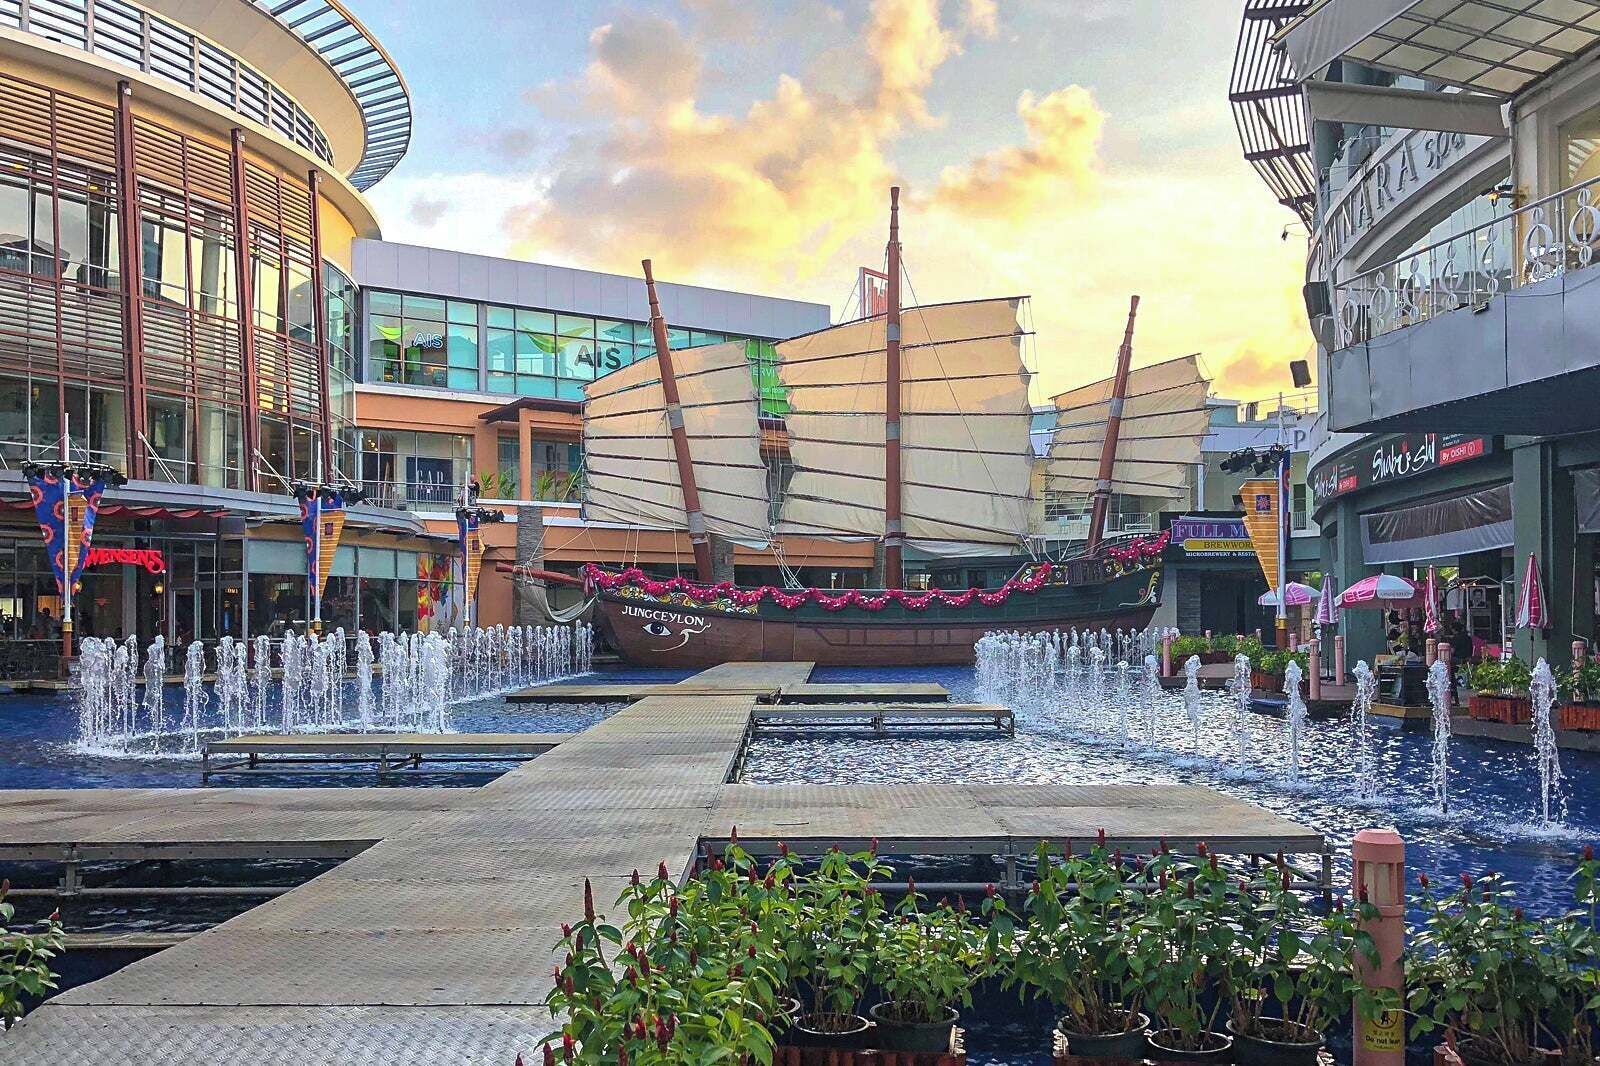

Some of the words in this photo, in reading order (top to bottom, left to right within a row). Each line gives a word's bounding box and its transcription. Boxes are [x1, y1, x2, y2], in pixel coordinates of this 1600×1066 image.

[412, 332, 444, 349] AIS
[574, 344, 622, 370] AIS
[1451, 447, 1467, 458] OISHI
[416, 469, 444, 491] GAP
[1174, 524, 1225, 538] FULL
[1203, 541, 1255, 549] BREWWOR
[82, 548, 165, 575] WENSEN'S
[621, 604, 706, 627] JUNGCEYLON
[1365, 1034, 1375, 1043] Do
